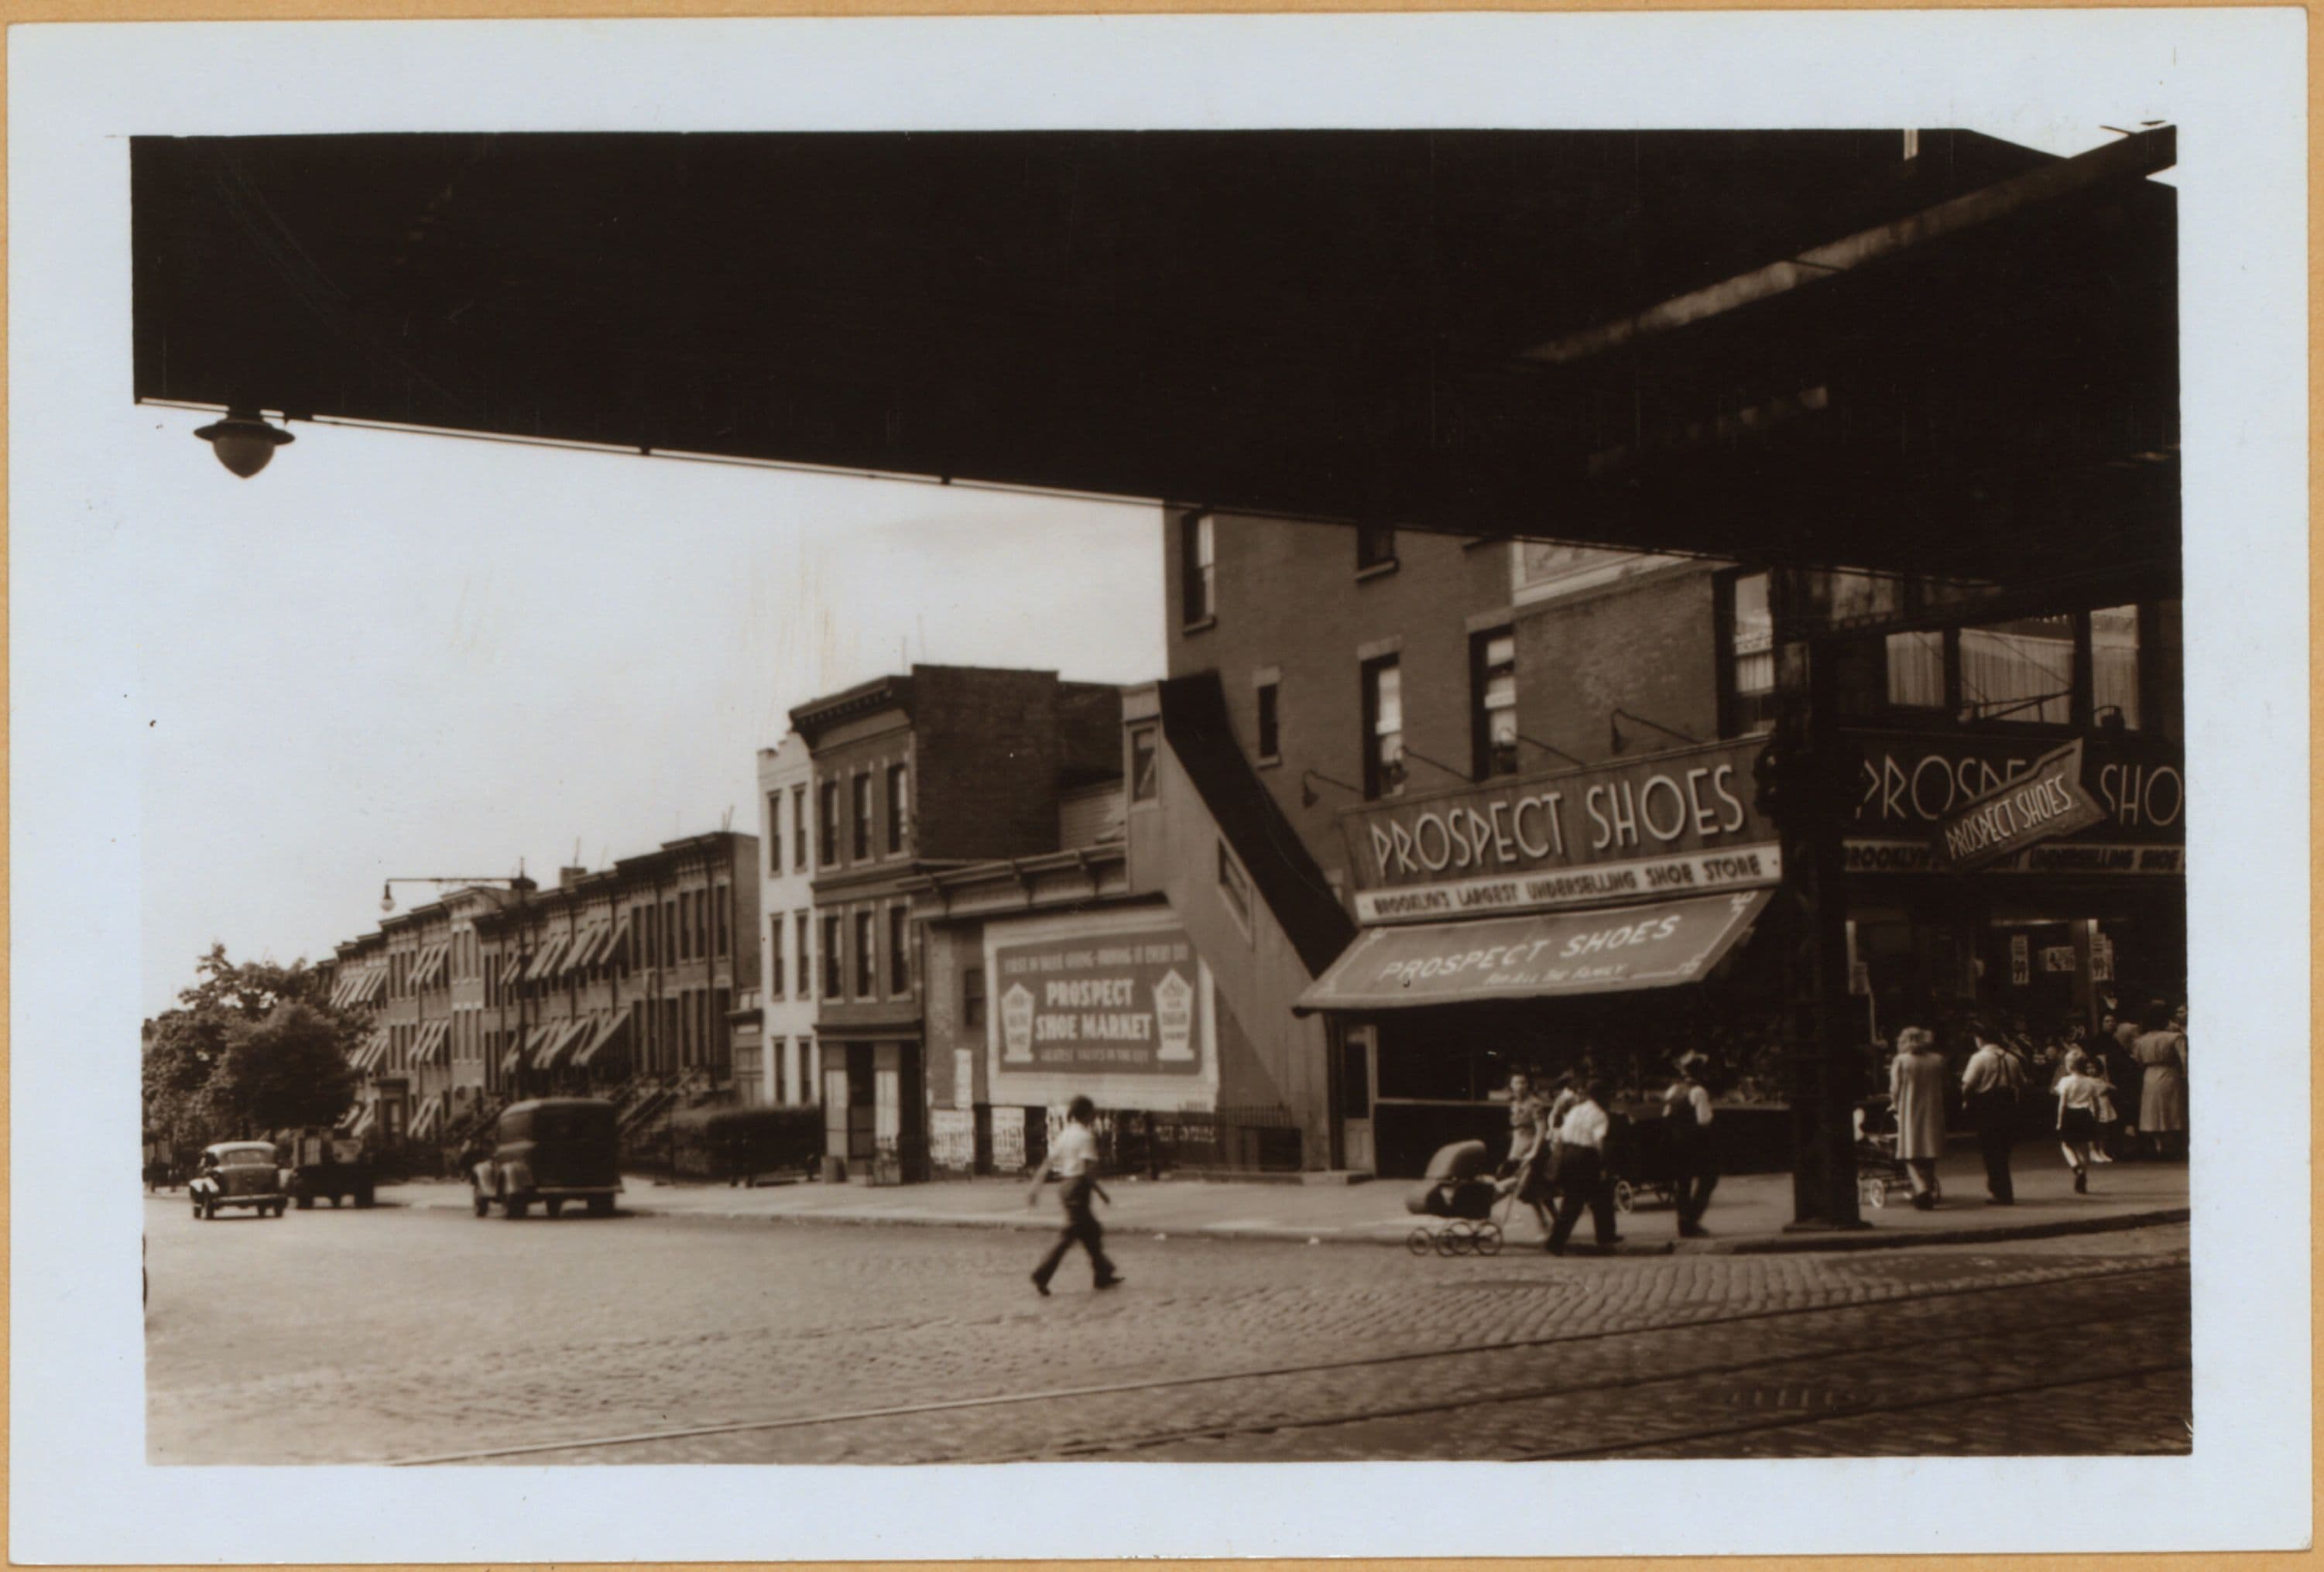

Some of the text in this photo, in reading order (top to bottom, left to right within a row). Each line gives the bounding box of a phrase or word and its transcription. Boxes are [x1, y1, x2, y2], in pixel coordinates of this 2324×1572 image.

[1369, 764, 1744, 877] PROSPECT SHOES
[1944, 774, 2072, 860] PROSPECT SHOES
[1455, 882, 1519, 906] LARGEST
[1526, 869, 1637, 900] UNDERSELLING
[1646, 862, 1694, 885] SHOE
[1702, 854, 1762, 882] STORE
[1380, 915, 1681, 981] PROSPECT SHOES
[1046, 978, 1134, 1007] PROSPECT
[1035, 1013, 1078, 1040] SHOE
[1082, 1012, 1152, 1040] MARKET
